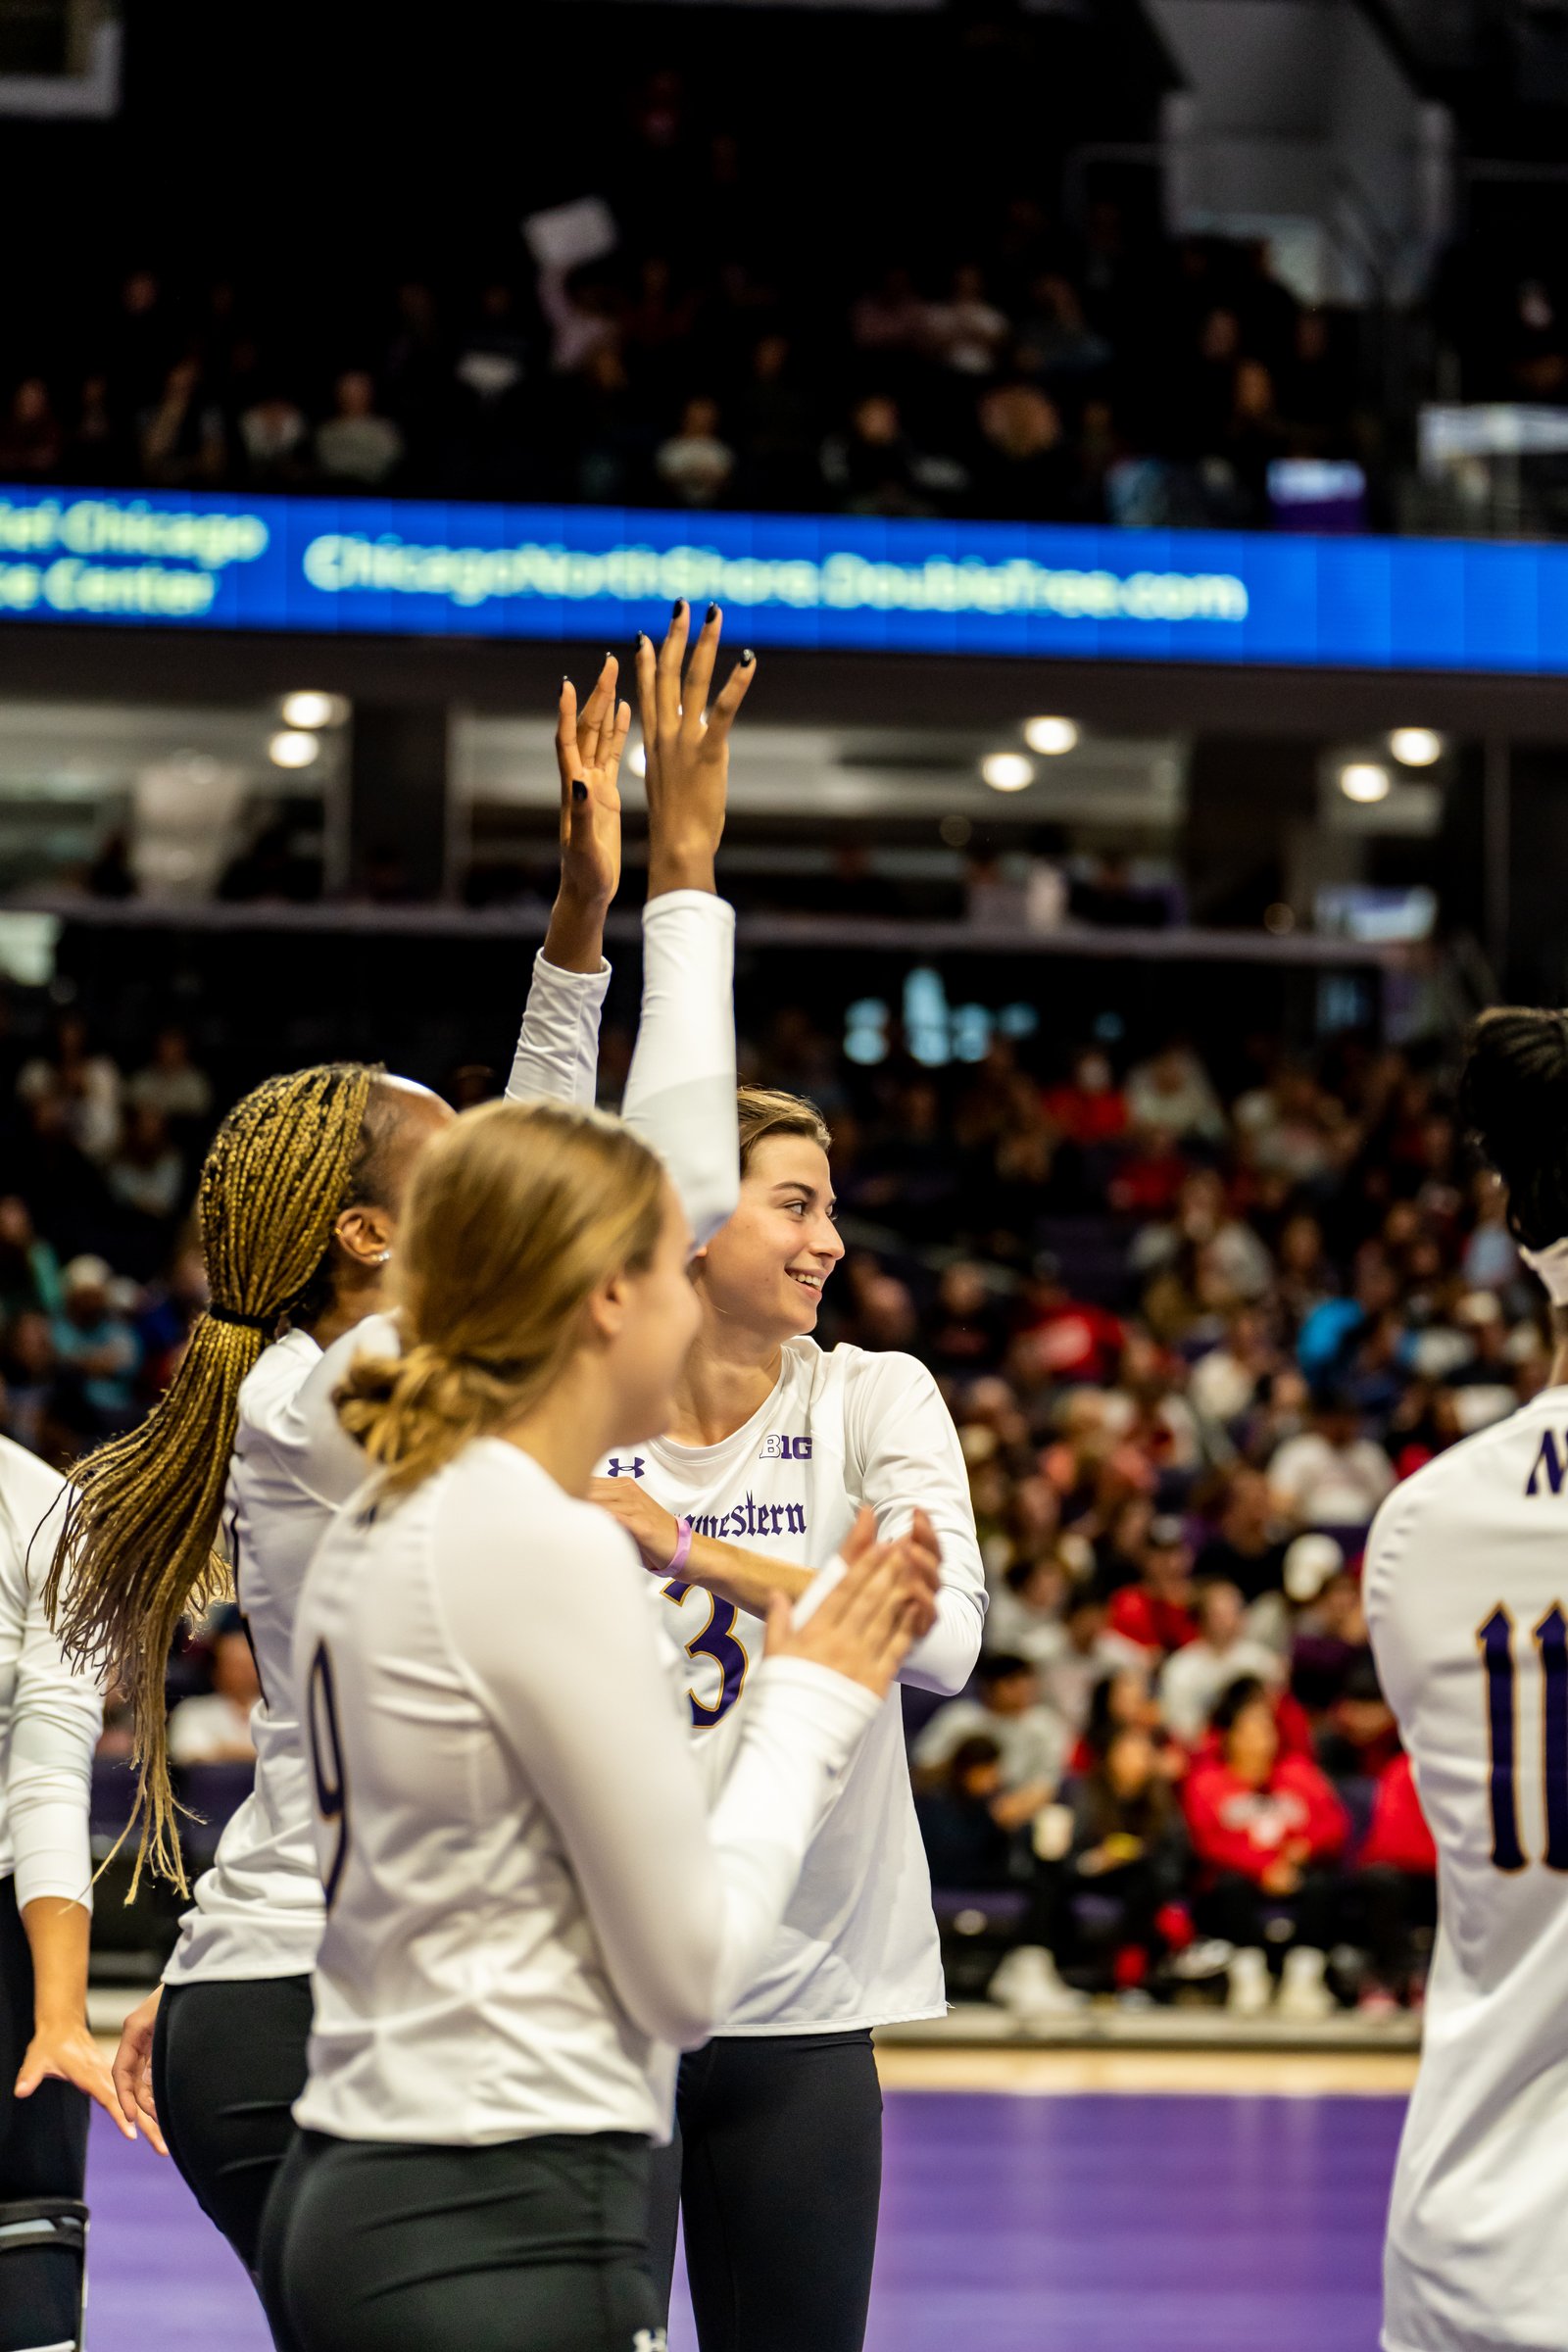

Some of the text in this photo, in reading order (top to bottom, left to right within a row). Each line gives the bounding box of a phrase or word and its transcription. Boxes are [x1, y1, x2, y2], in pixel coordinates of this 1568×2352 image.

[65, 499, 268, 568] Chicago
[660, 1579, 749, 1729] 3
[1476, 1600, 1568, 1874] 11
